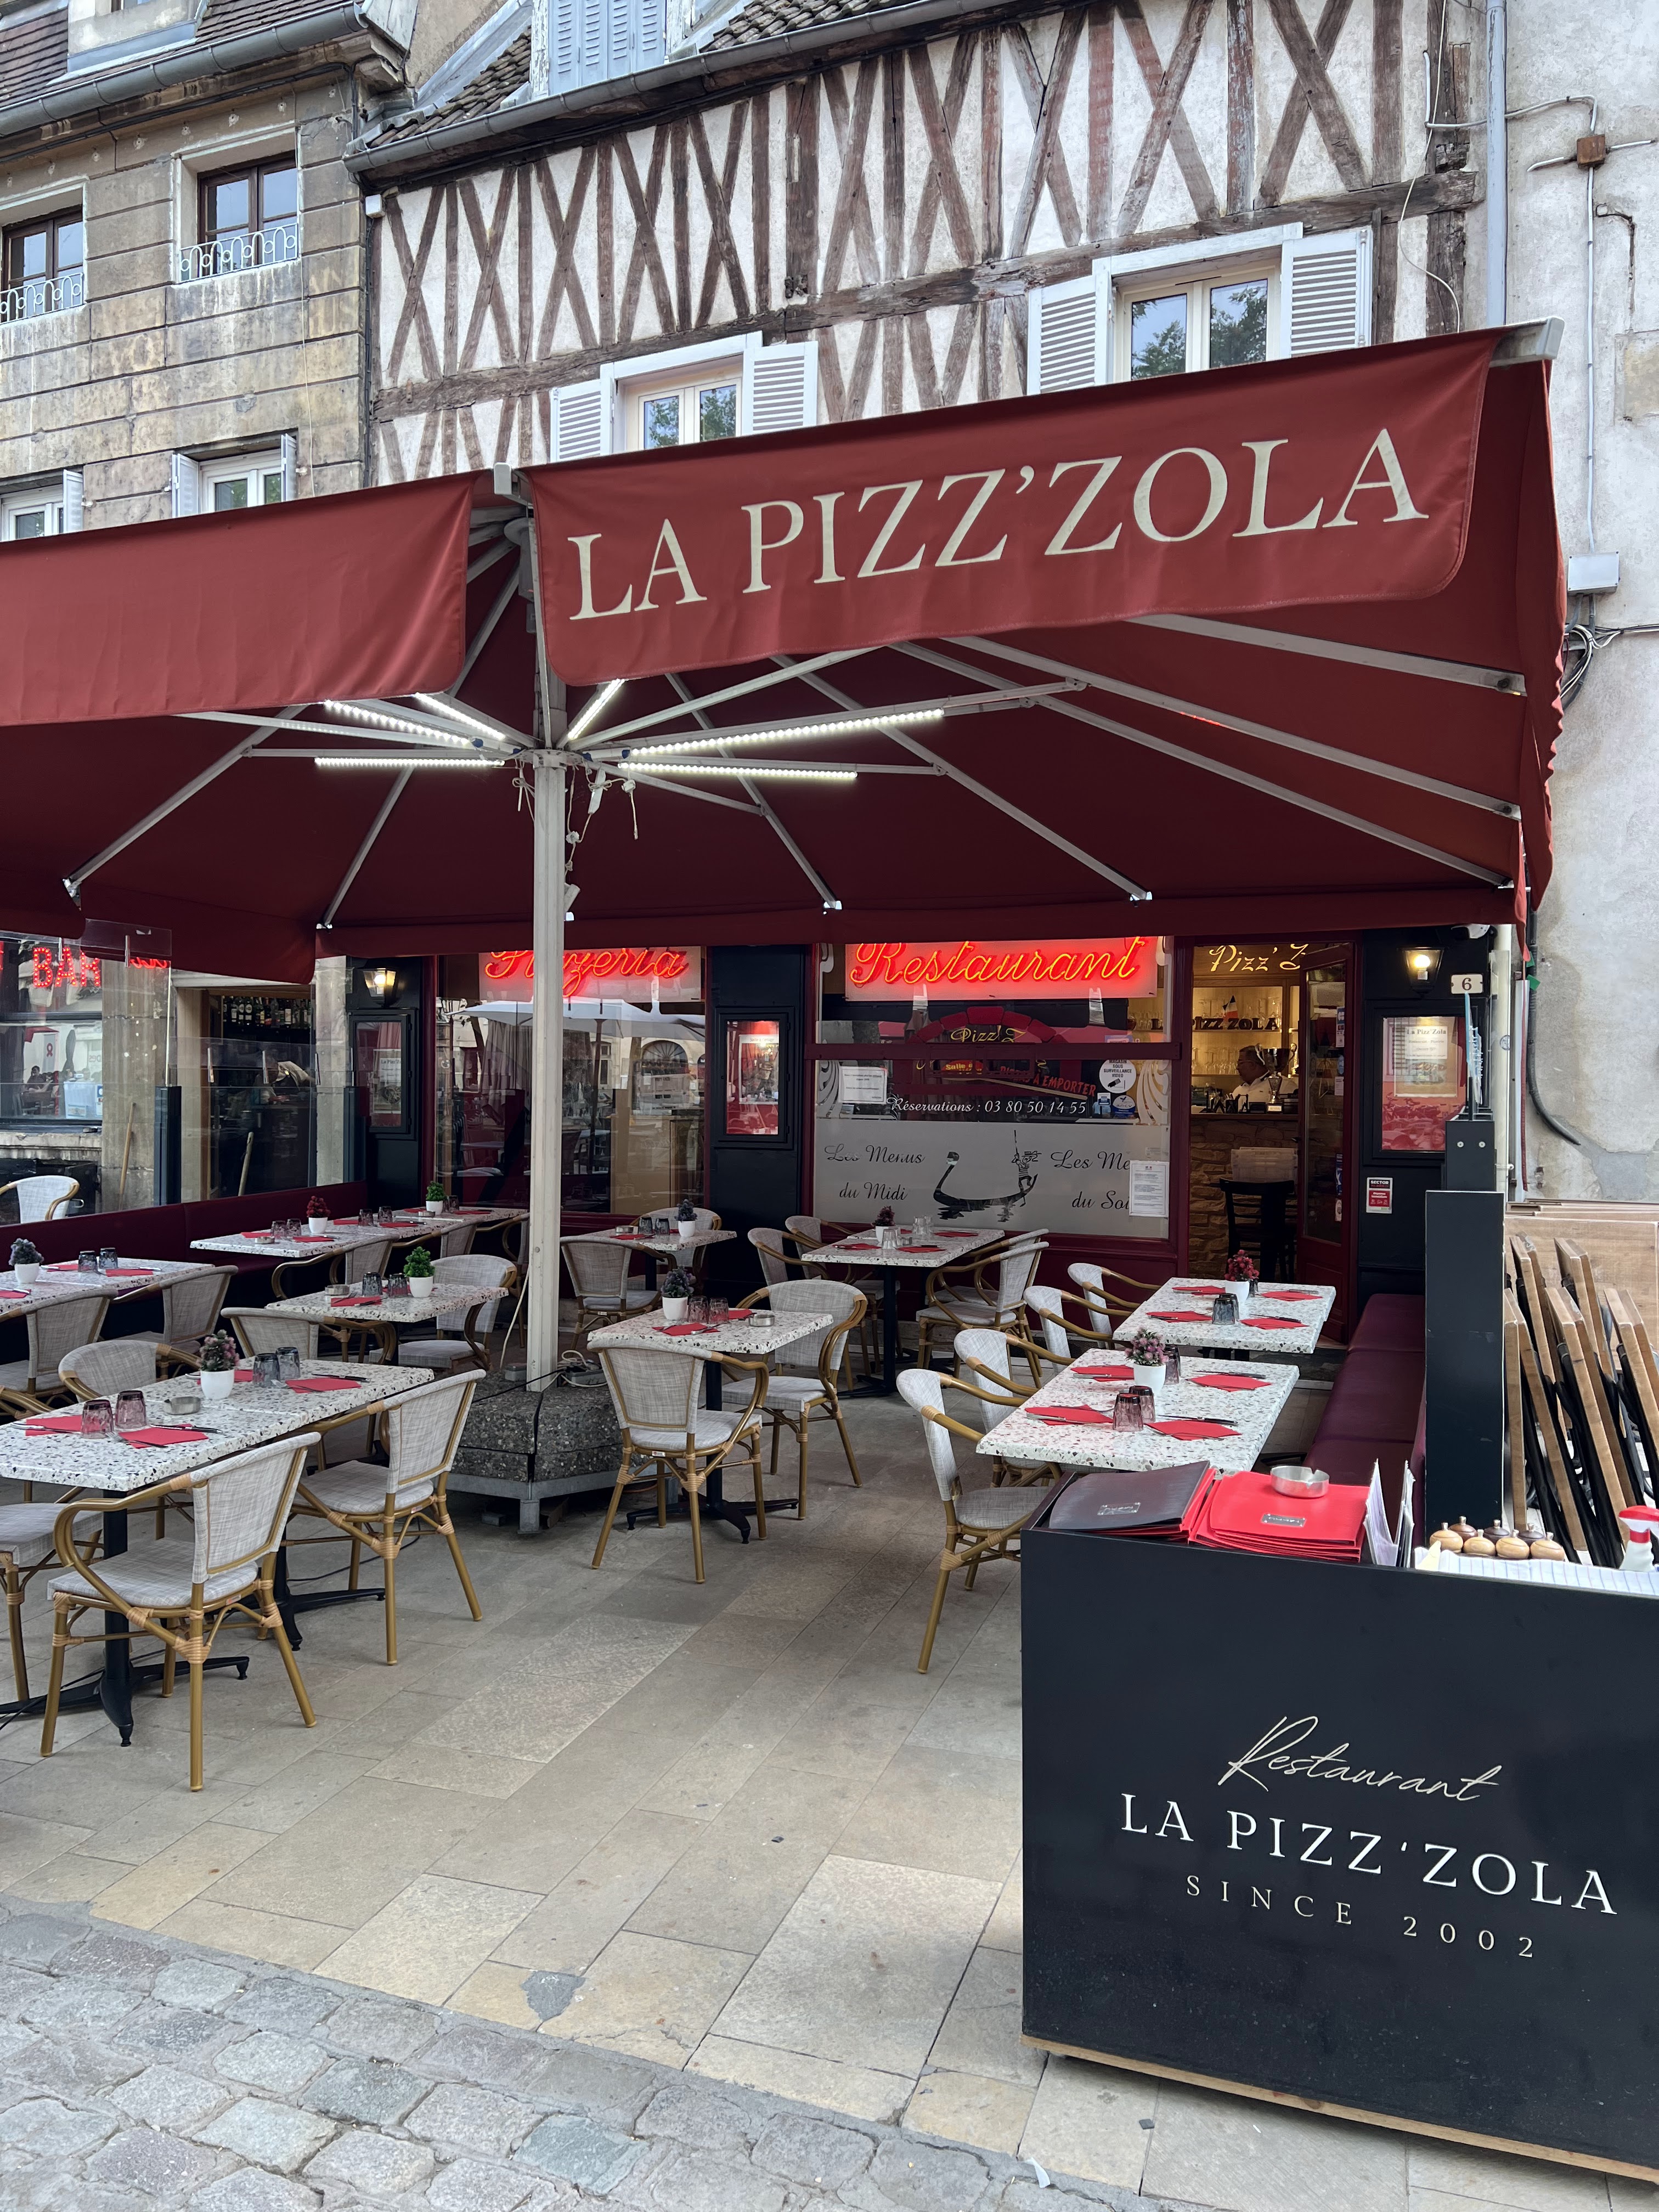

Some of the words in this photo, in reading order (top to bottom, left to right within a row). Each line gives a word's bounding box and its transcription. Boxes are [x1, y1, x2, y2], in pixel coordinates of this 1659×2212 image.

[567, 518, 707, 620] LA
[33, 947, 100, 988] BAR
[485, 949, 684, 997] Pzeria
[849, 936, 1146, 985] Restaurant
[1462, 977, 1472, 991] 6
[1042, 1075, 1096, 1097] EMPORTER
[887, 1097, 973, 1113] Réservations
[985, 1101, 1000, 1113] 03
[1006, 1101, 1022, 1113] 80
[1027, 1101, 1043, 1113] 50
[1049, 1101, 1064, 1114] 14
[1070, 1102, 1086, 1114] 55
[825, 1143, 860, 1161] Les
[866, 1144, 926, 1164] Menus
[1051, 1149, 1093, 1169] Les
[839, 1182, 860, 1198] du
[864, 1182, 909, 1200] Midi
[1071, 1191, 1096, 1208] du
[1101, 1190, 1130, 1210] Soi
[1217, 1716, 1502, 1801] Restaurant
[1121, 1793, 1194, 1842] LA
[1227, 1810, 1618, 1915] PIZZ'ZOLA
[1187, 1875, 1352, 1925] SINCE
[1403, 1916, 1533, 1959] 2002
